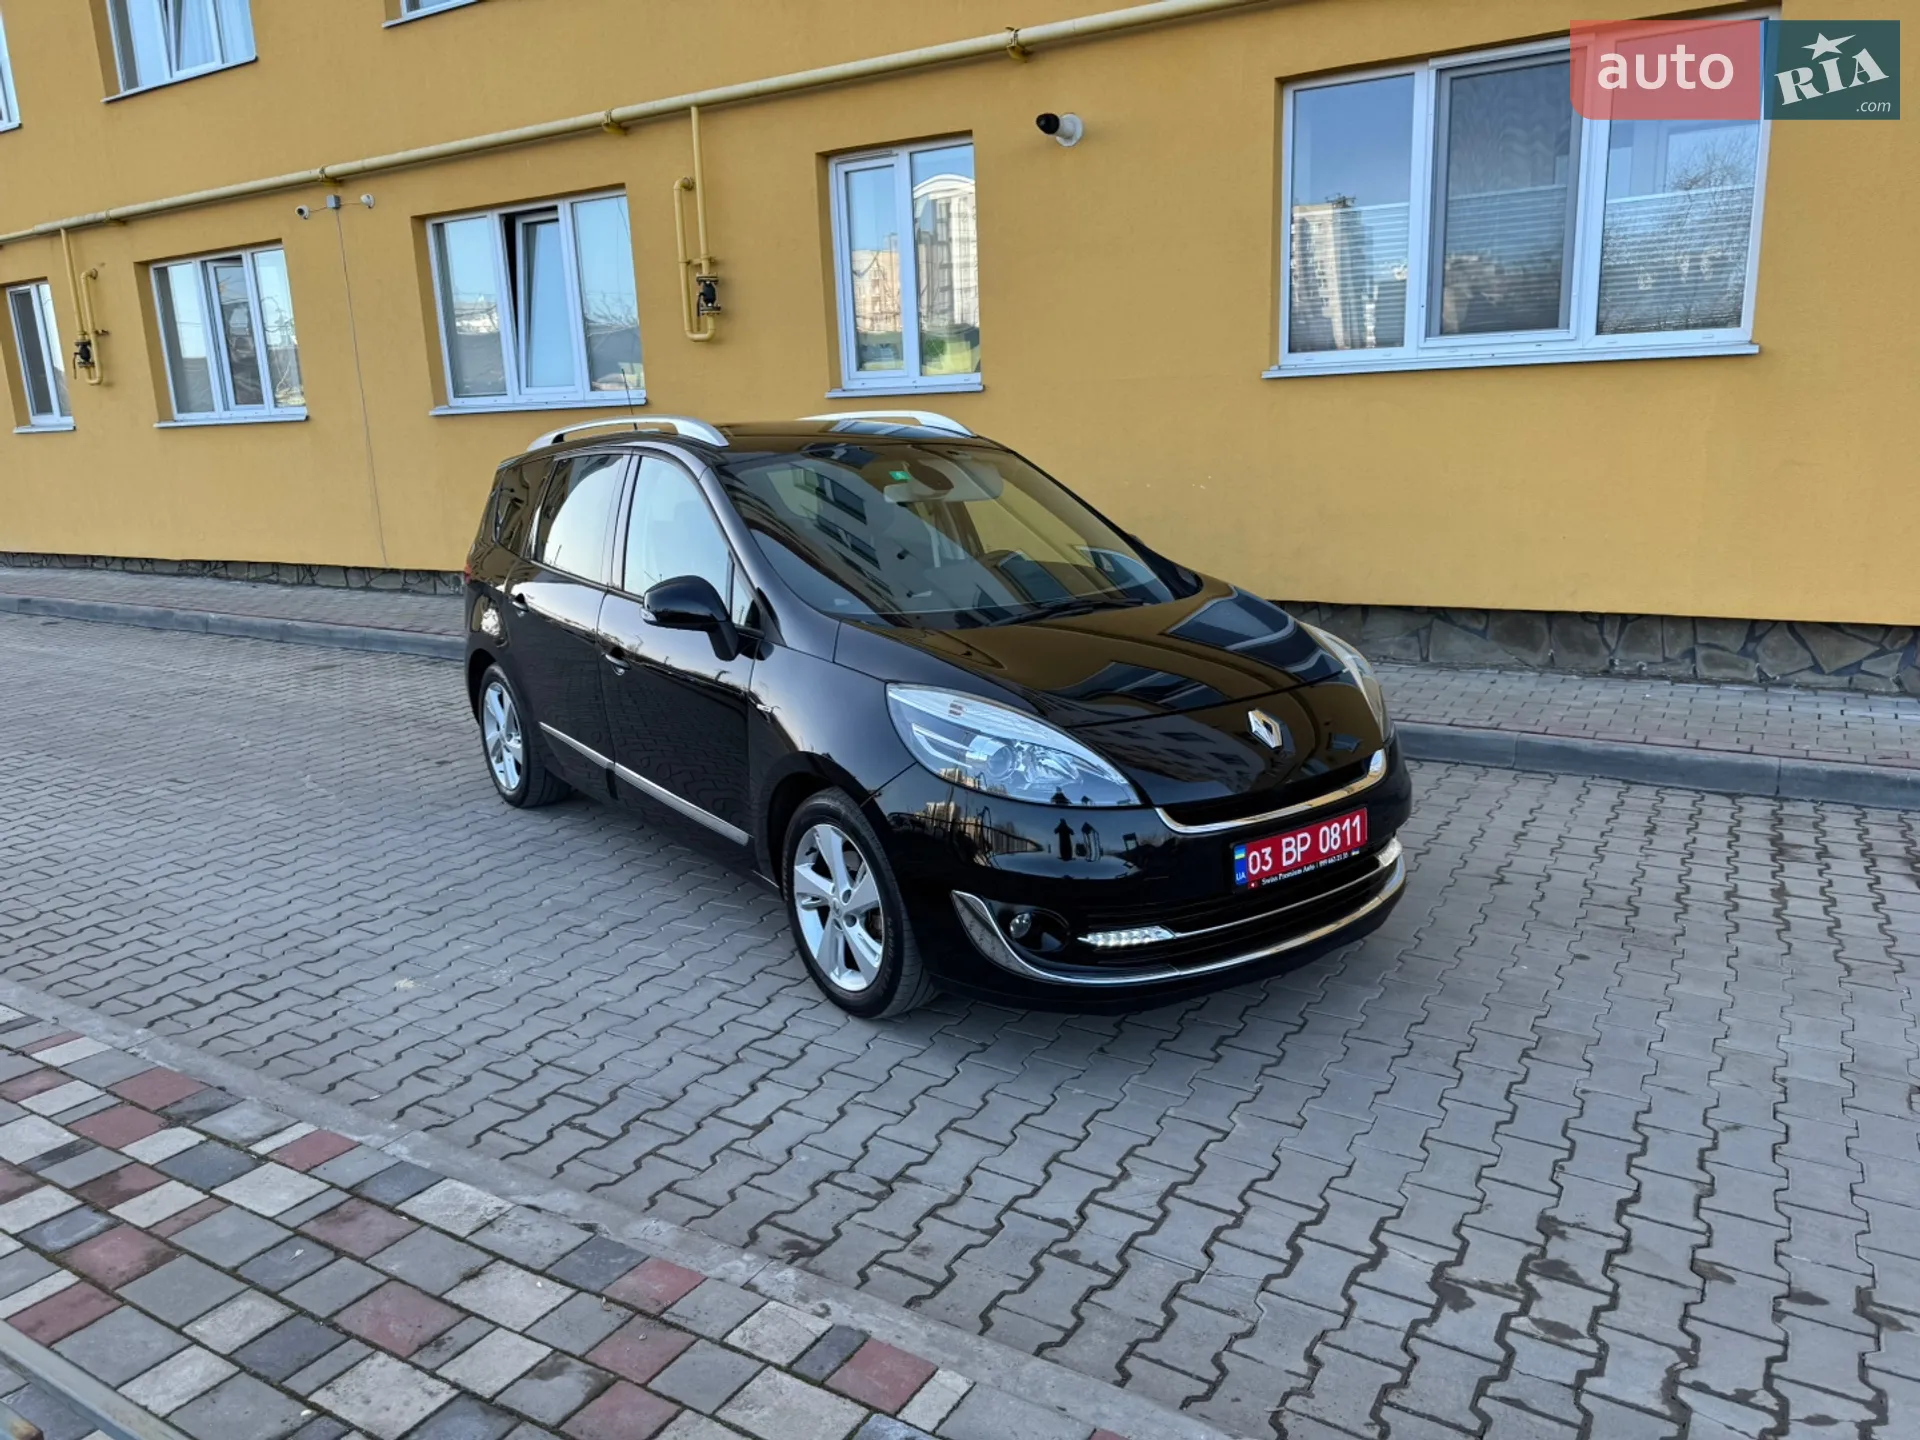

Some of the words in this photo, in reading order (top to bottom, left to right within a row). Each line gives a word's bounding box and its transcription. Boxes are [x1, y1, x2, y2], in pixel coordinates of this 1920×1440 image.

[1248, 846, 1272, 875] 03
[1282, 832, 1311, 867] BP
[1319, 814, 1361, 854] 0811
[1303, 864, 1316, 874] Auto
[1235, 873, 1246, 881] UA
